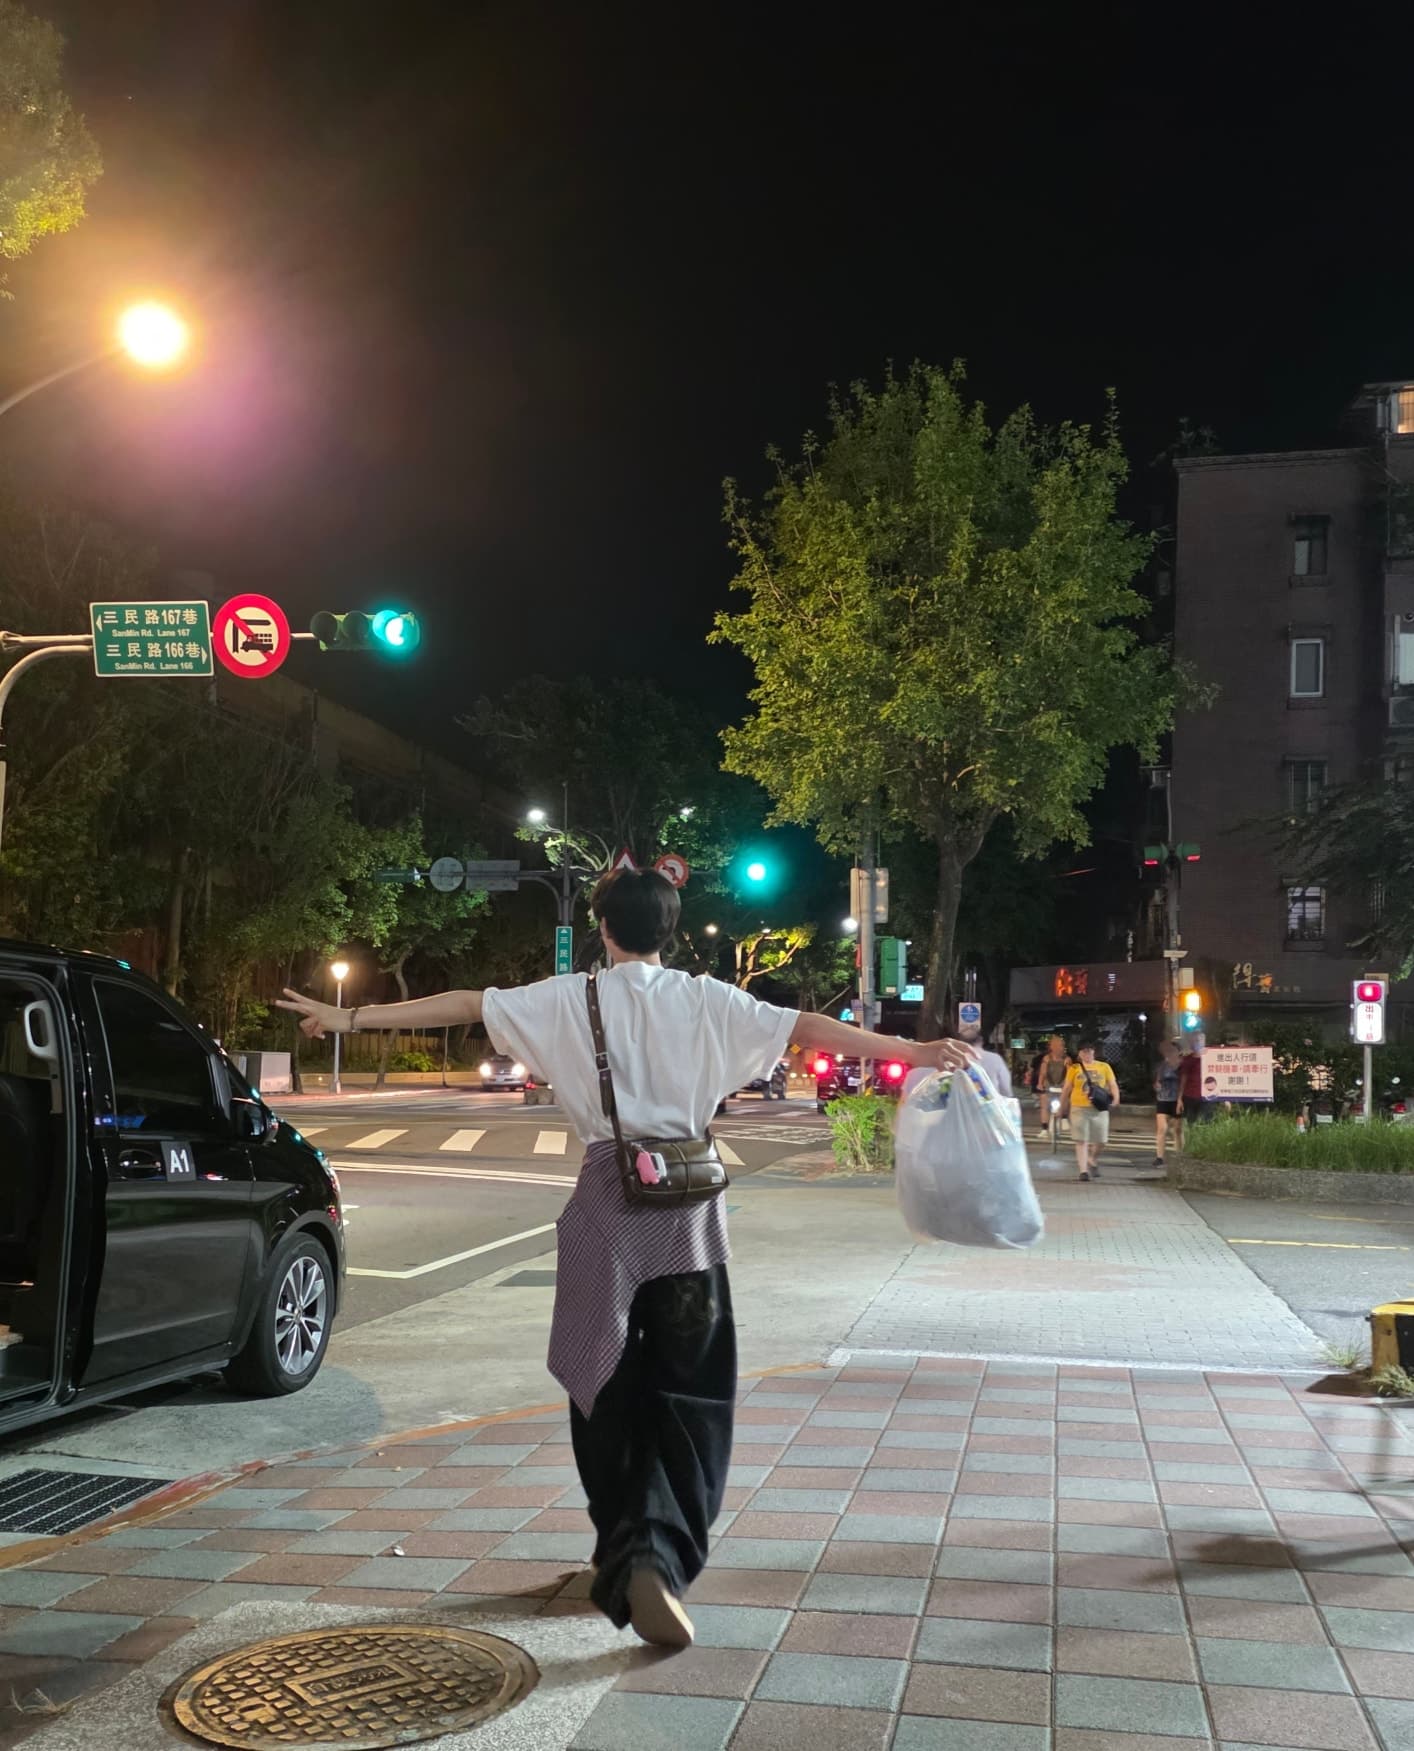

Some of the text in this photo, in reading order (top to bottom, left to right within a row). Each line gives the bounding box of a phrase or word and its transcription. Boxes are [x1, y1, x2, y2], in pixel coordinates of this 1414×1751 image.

[103, 608, 198, 625] 三民路167巷
[141, 629, 154, 637] Rd.
[157, 629, 176, 637] Lane
[177, 629, 190, 637] 167
[106, 642, 201, 658] 三民路166巷
[143, 662, 156, 670] Rd.
[160, 662, 178, 670] Lane
[180, 662, 193, 670] 166
[559, 936, 569, 971] 三民路
[170, 1149, 190, 1173] A1
